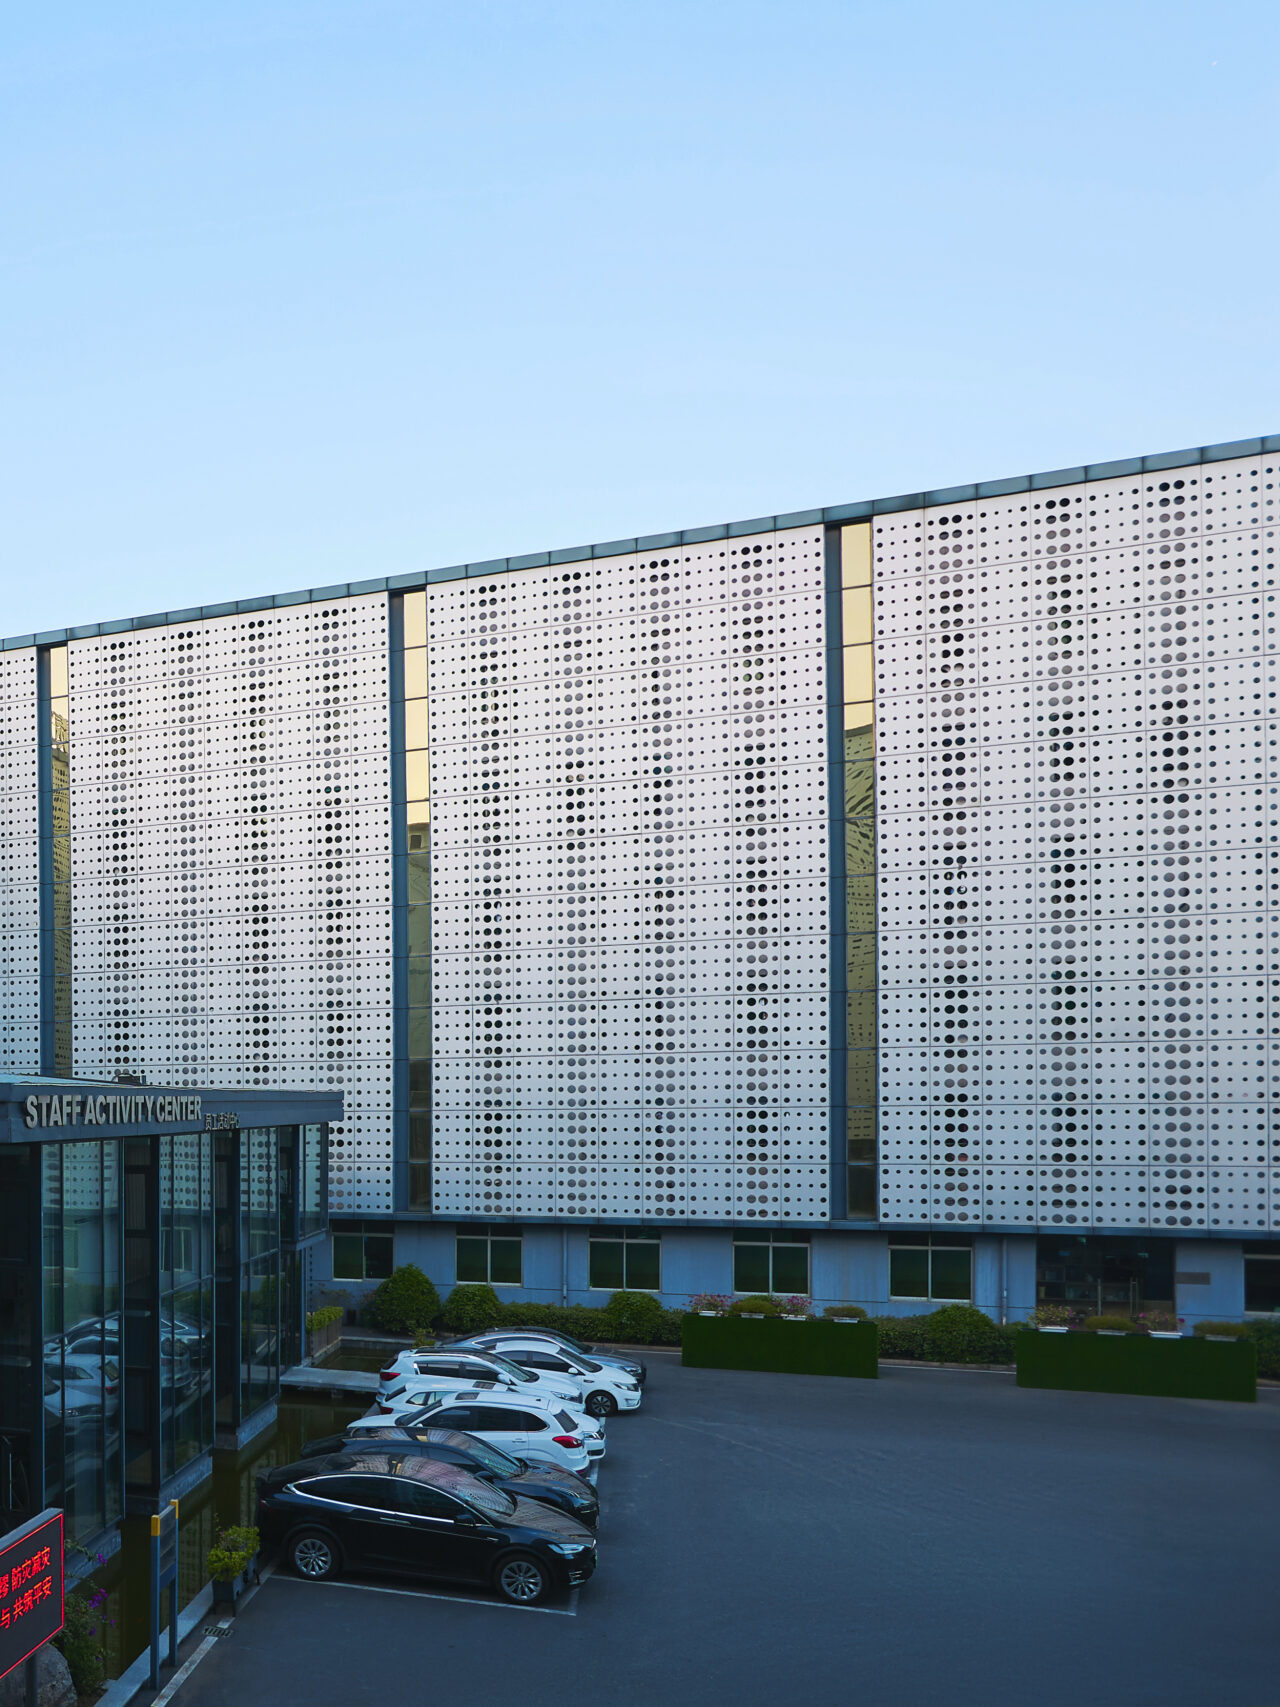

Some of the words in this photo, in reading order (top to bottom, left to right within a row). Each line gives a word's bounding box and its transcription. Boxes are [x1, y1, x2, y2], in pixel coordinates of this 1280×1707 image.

[26, 1095, 81, 1128] STAFF
[84, 1095, 154, 1125] ACTIVITY
[156, 1095, 202, 1122] CENTER
